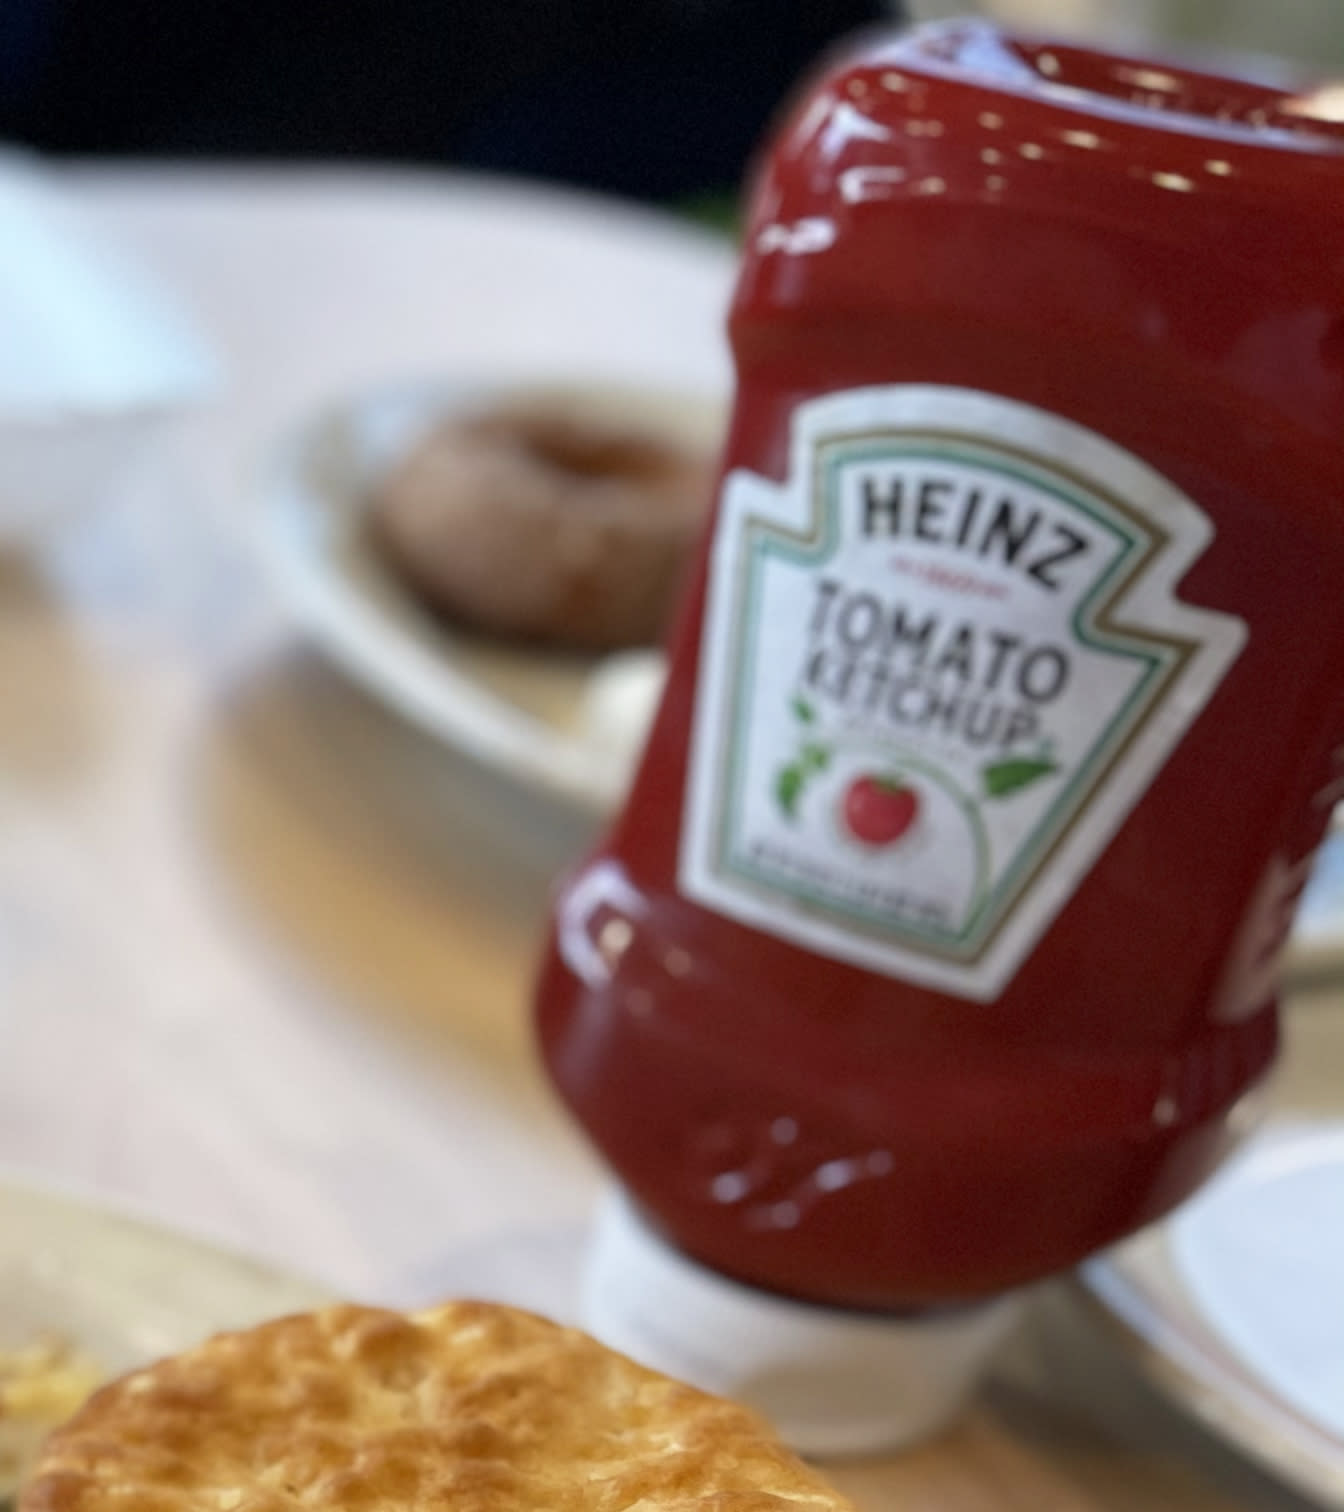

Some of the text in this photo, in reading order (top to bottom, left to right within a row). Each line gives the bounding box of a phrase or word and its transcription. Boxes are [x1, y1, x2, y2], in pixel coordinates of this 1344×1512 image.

[861, 474, 1088, 592] HEINZ
[805, 648, 1040, 749] KETCHUP
[816, 579, 1070, 704] TOMATO
